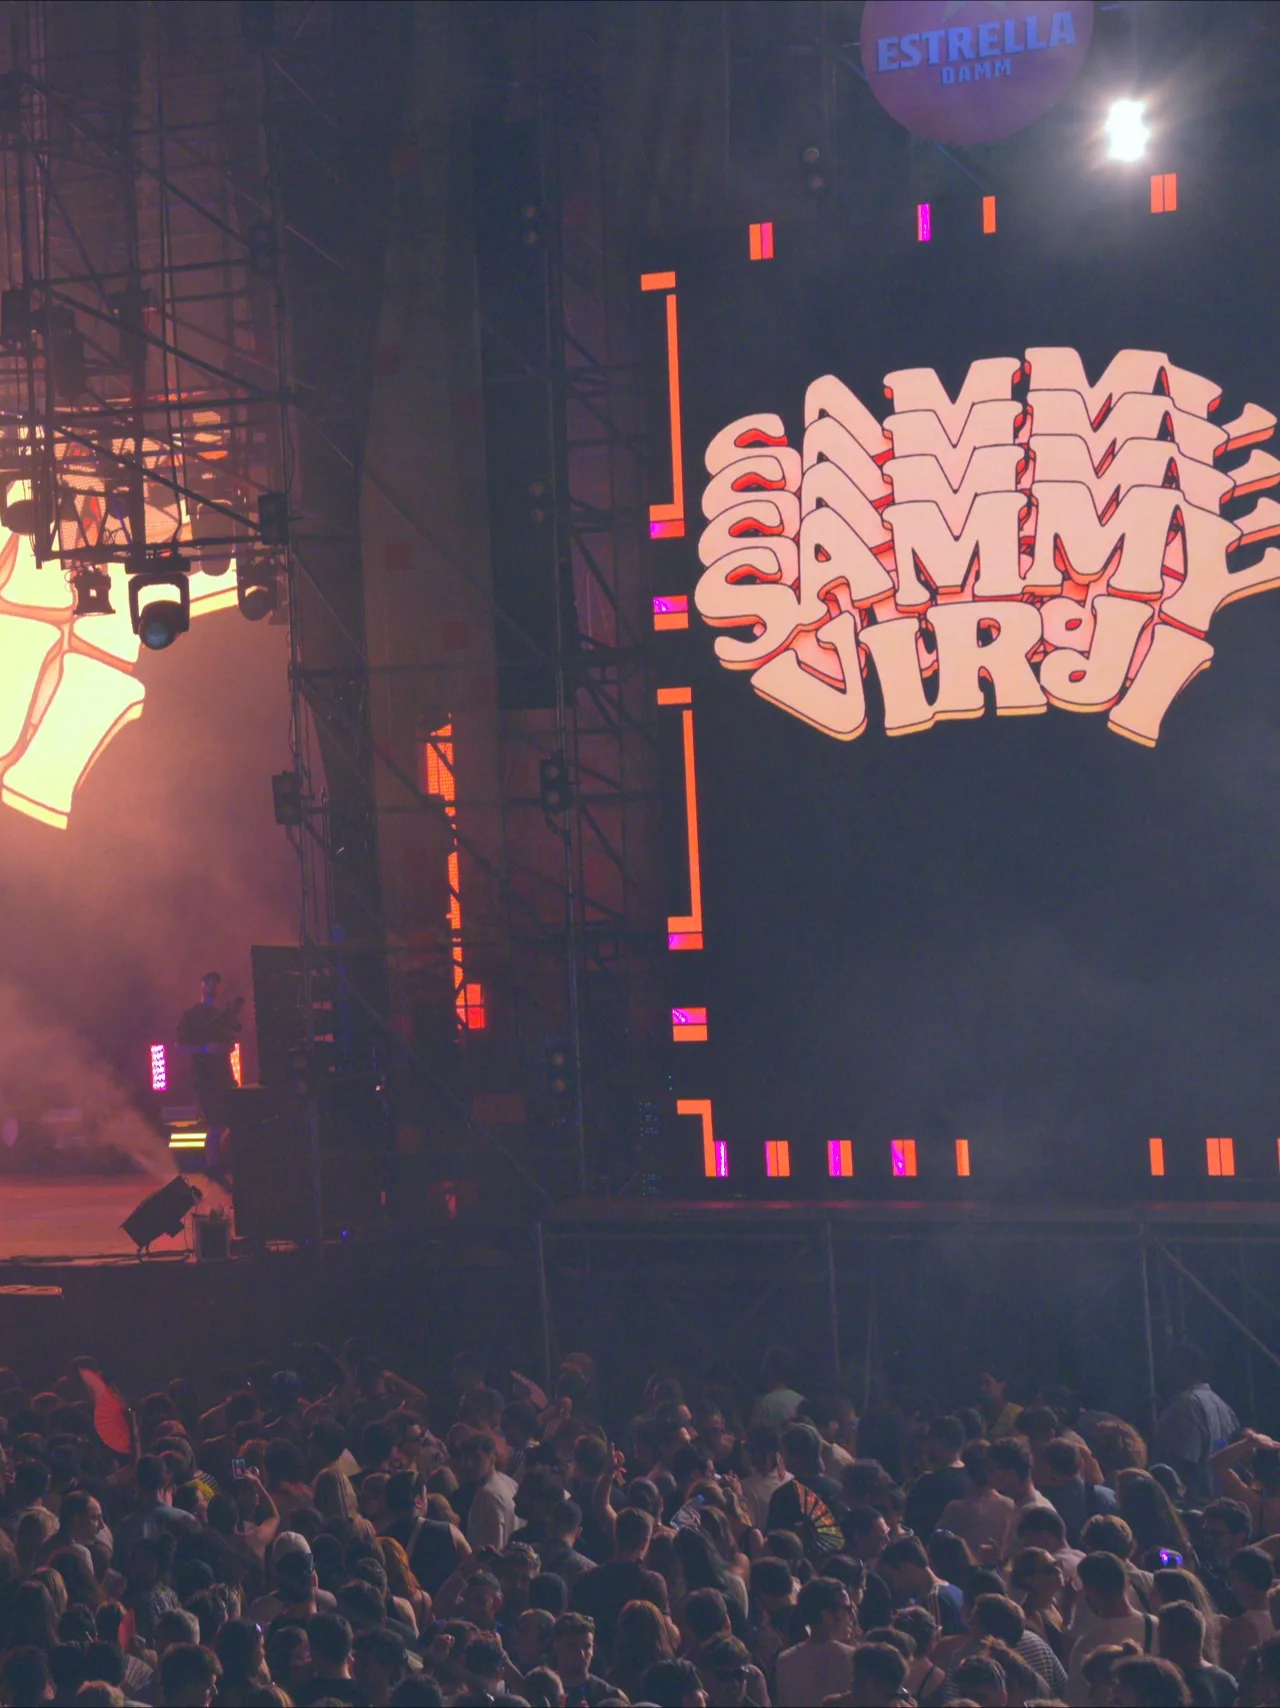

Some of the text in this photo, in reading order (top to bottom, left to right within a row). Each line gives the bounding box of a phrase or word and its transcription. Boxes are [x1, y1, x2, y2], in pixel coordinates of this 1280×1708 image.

[876, 10, 1077, 72] ESTRELLA
[940, 58, 1013, 85] DAMM
[695, 480, 1280, 671] SAMMY
